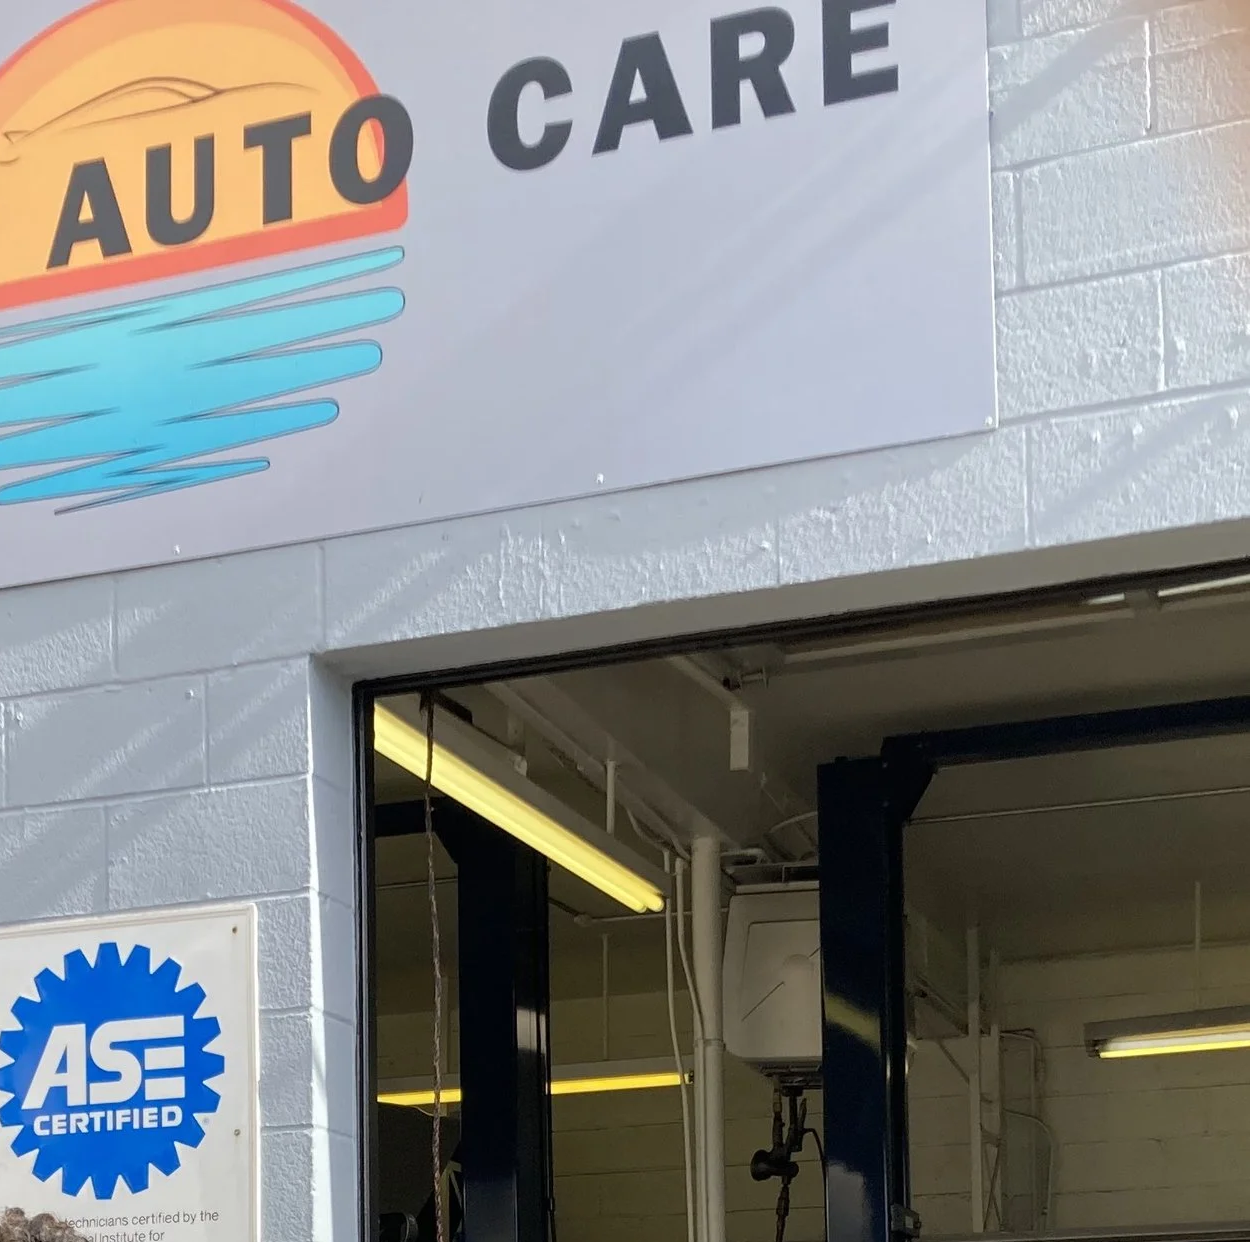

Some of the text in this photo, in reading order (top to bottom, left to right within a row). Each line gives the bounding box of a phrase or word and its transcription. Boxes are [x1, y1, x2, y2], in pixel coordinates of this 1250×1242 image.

[46, 93, 414, 270] AUTO
[486, 0, 900, 172] CARE
[20, 1014, 186, 1110] ASE
[33, 1104, 183, 1137] CERTIFIED
[131, 1211, 180, 1226] certified
[182, 1211, 198, 1225] by
[199, 1209, 219, 1222] the
[149, 1229, 165, 1242] for
